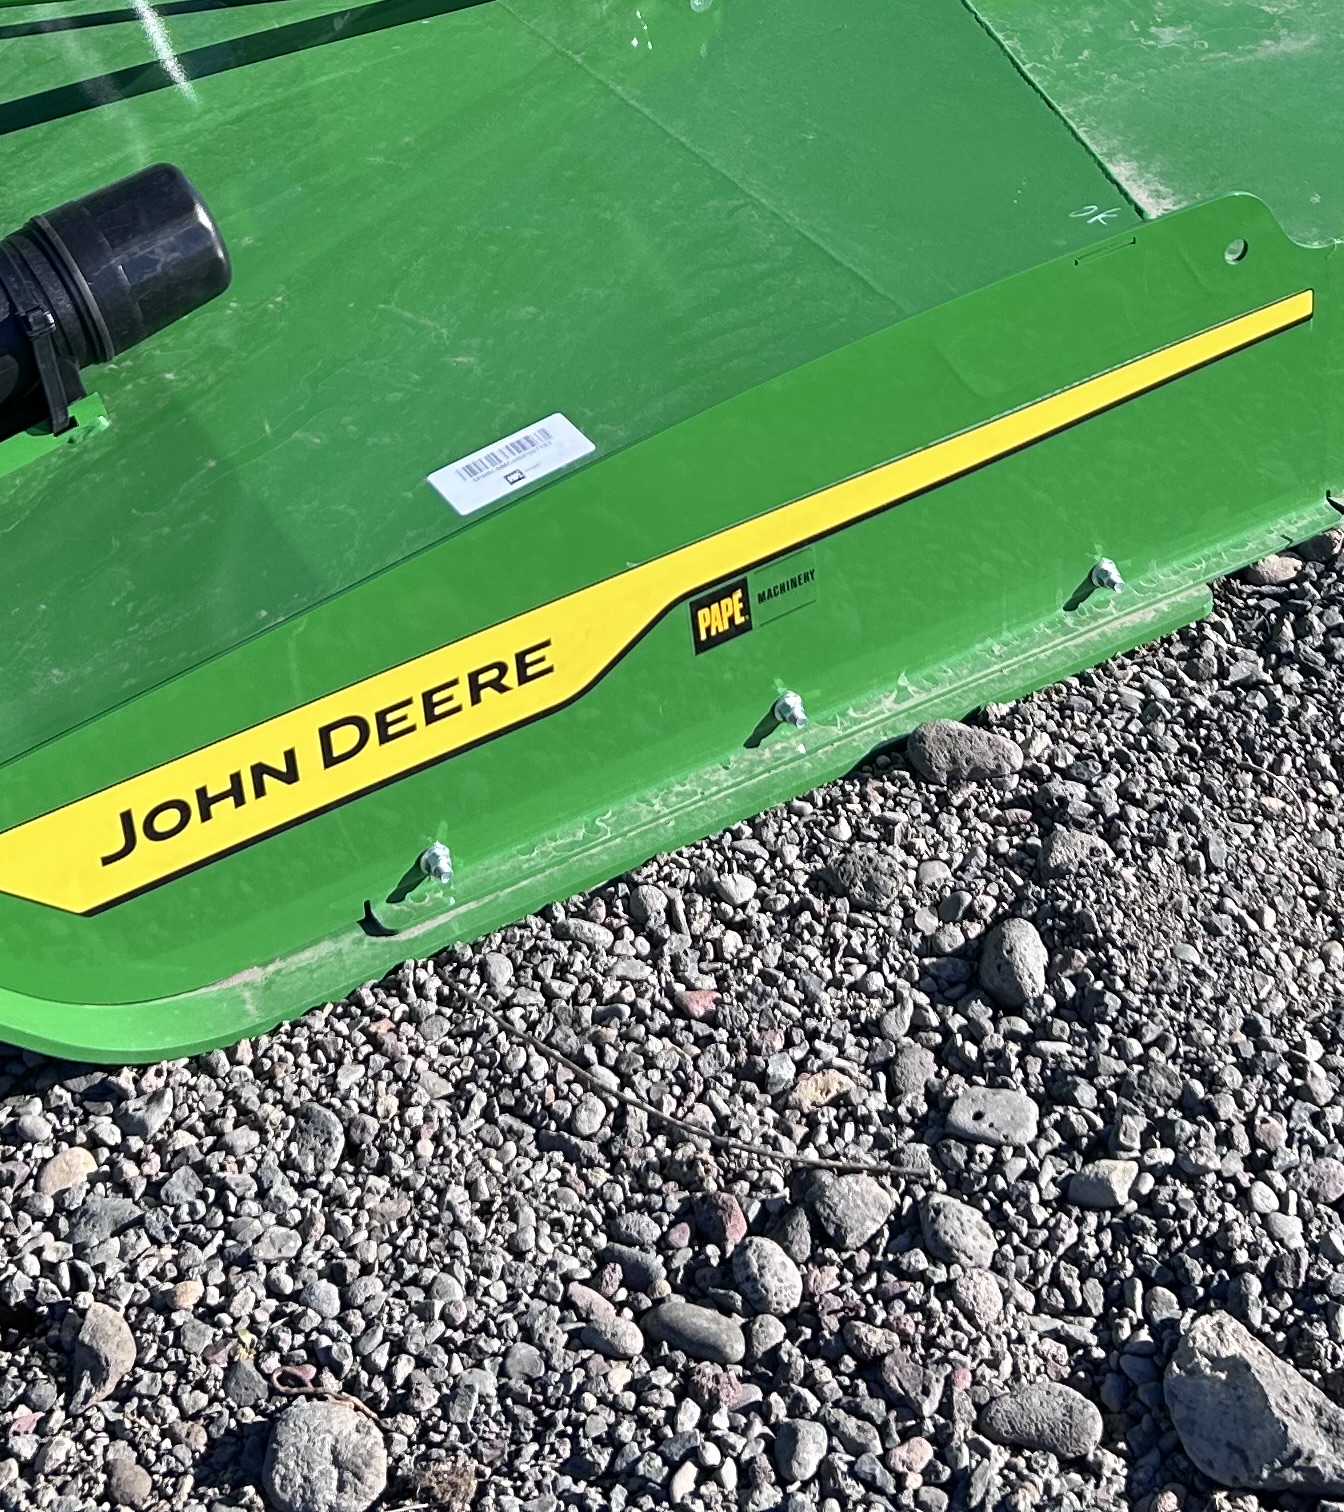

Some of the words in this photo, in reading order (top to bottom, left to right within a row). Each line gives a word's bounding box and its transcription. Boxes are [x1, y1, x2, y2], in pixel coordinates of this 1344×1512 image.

[757, 568, 816, 604] MACHINERY
[100, 746, 300, 866] JOHN
[317, 638, 555, 770] DEERE
